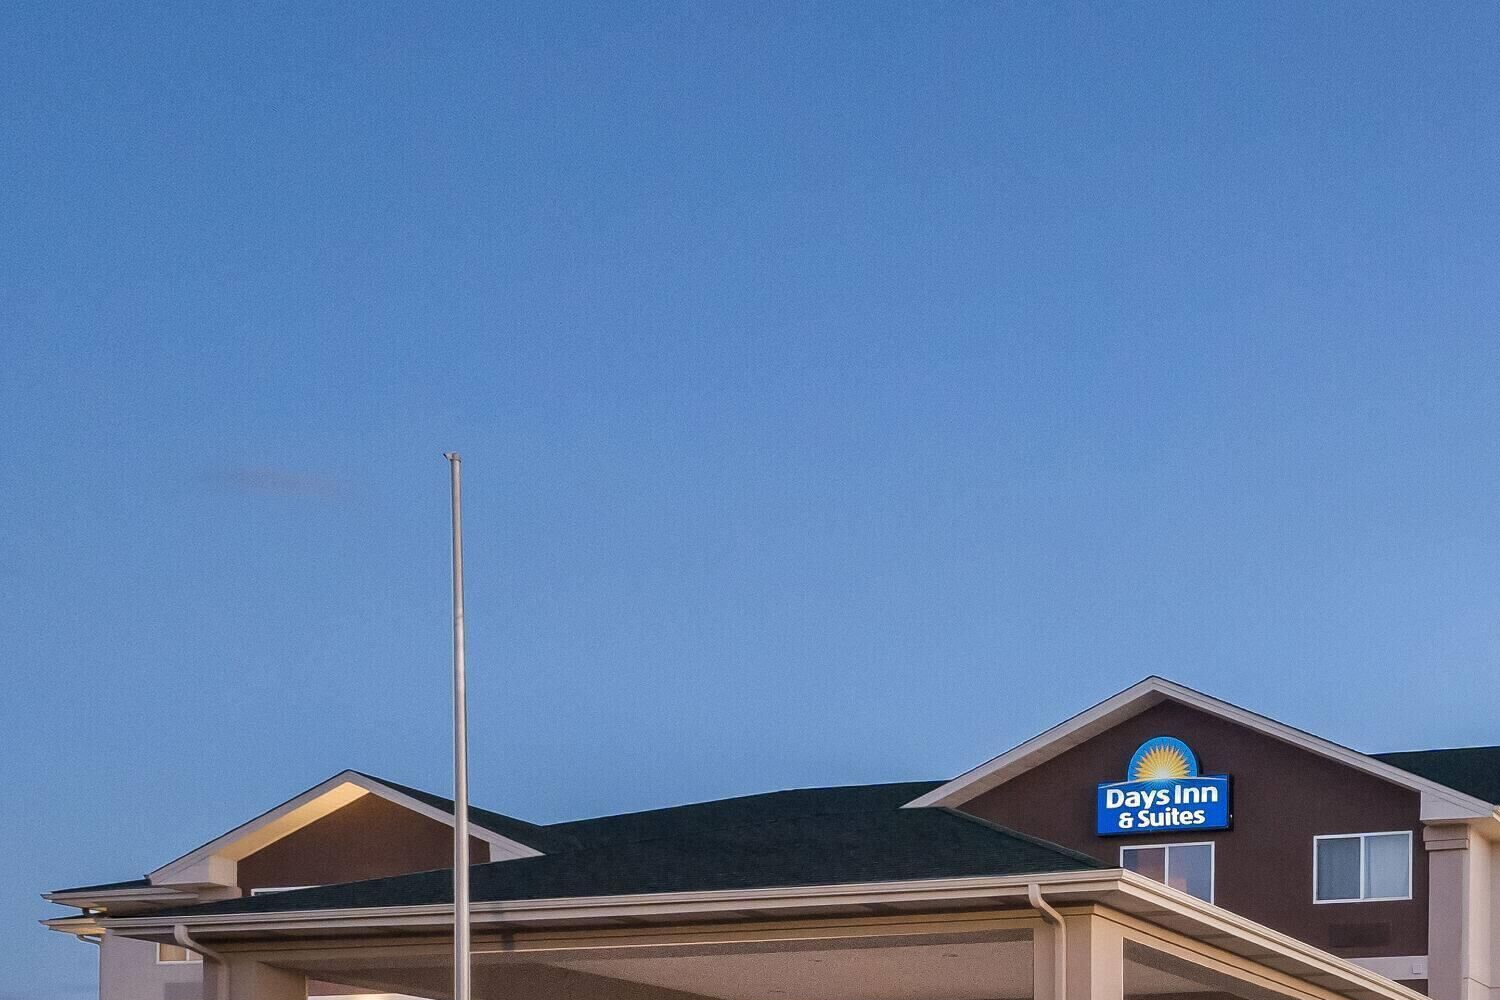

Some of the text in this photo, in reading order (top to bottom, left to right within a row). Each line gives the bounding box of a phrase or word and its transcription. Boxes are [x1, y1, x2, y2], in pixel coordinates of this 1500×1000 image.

[1106, 785, 1218, 809] Days Inn
[1118, 807, 1206, 829] & Suites
